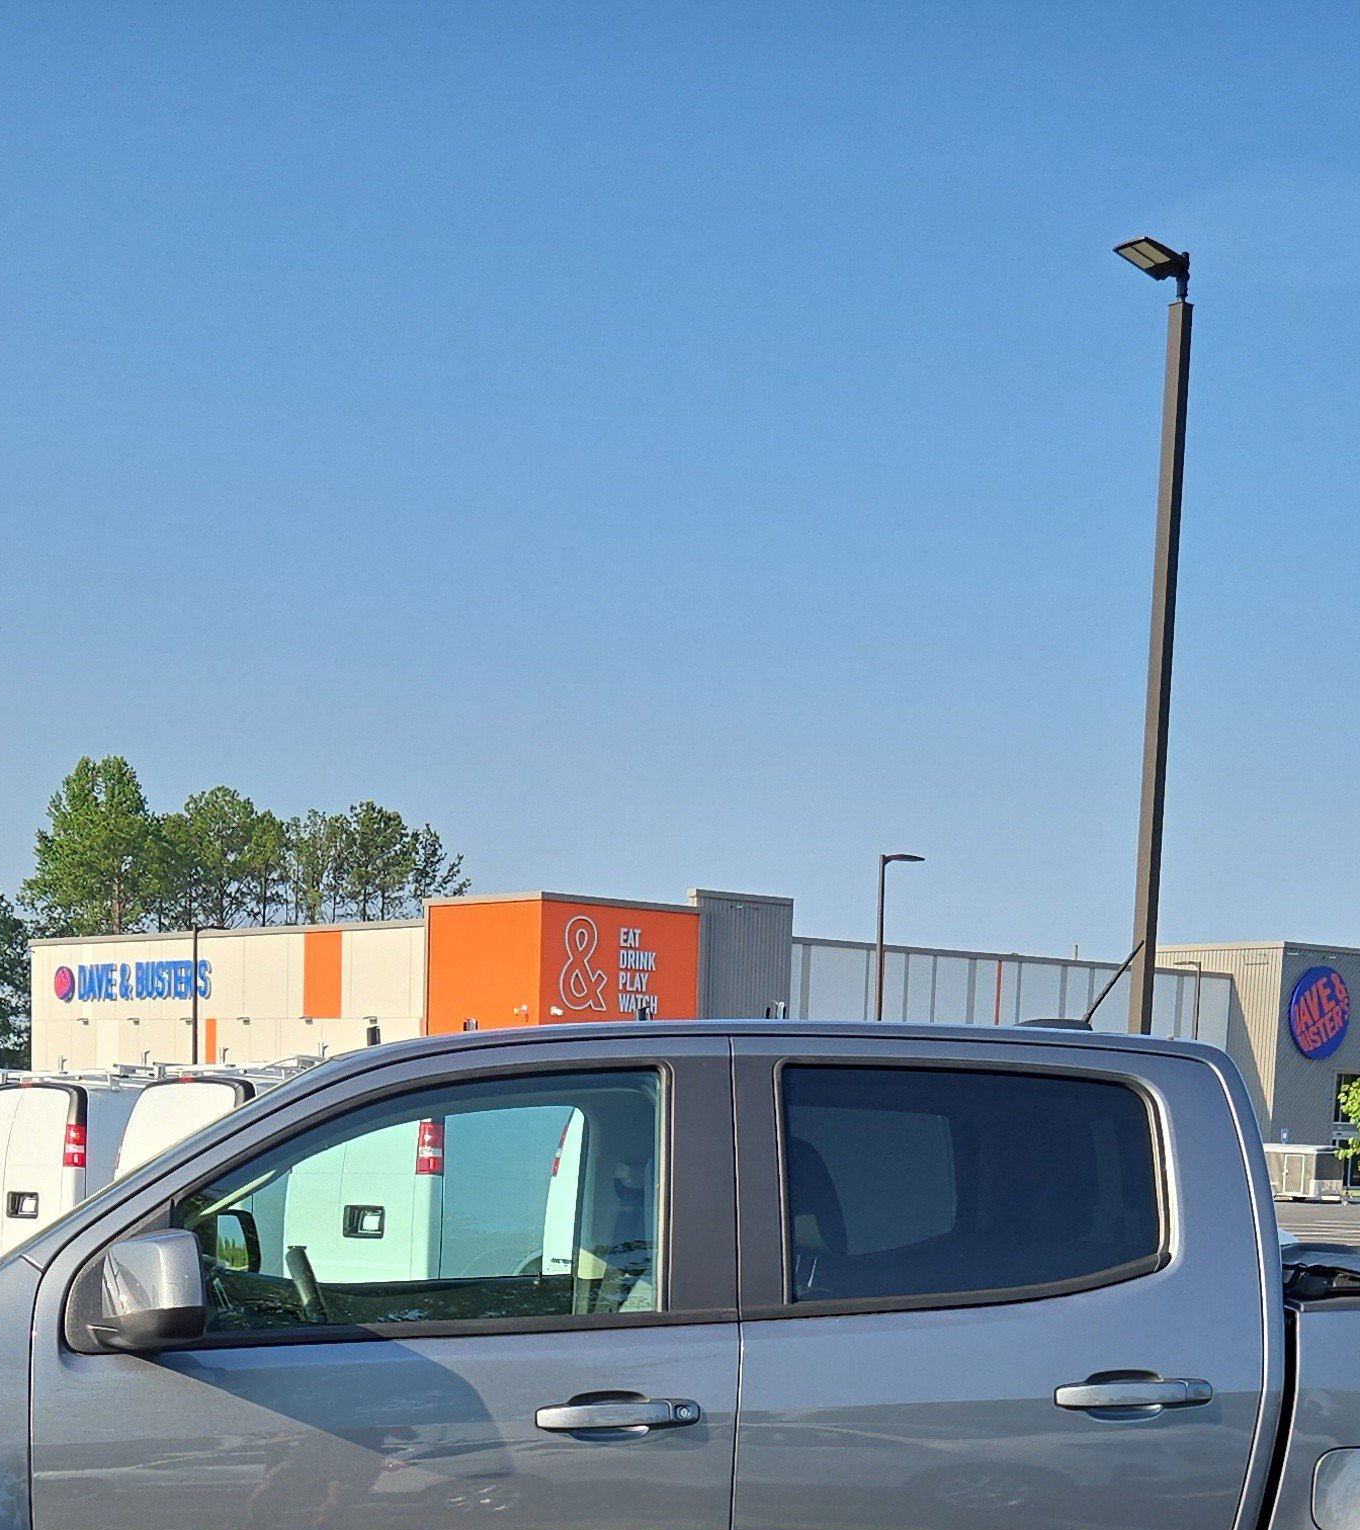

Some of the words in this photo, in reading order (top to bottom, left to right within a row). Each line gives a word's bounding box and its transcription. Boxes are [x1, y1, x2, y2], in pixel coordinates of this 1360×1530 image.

[619, 927, 641, 948] EAT
[619, 950, 657, 971] DRINK
[78, 963, 117, 1001] DAVE
[119, 963, 134, 1000] &
[135, 959, 212, 1000] BUSTERS
[618, 972, 649, 992] PLAY
[618, 993, 658, 1015] WATCH
[1293, 977, 1336, 1036] DAVE
